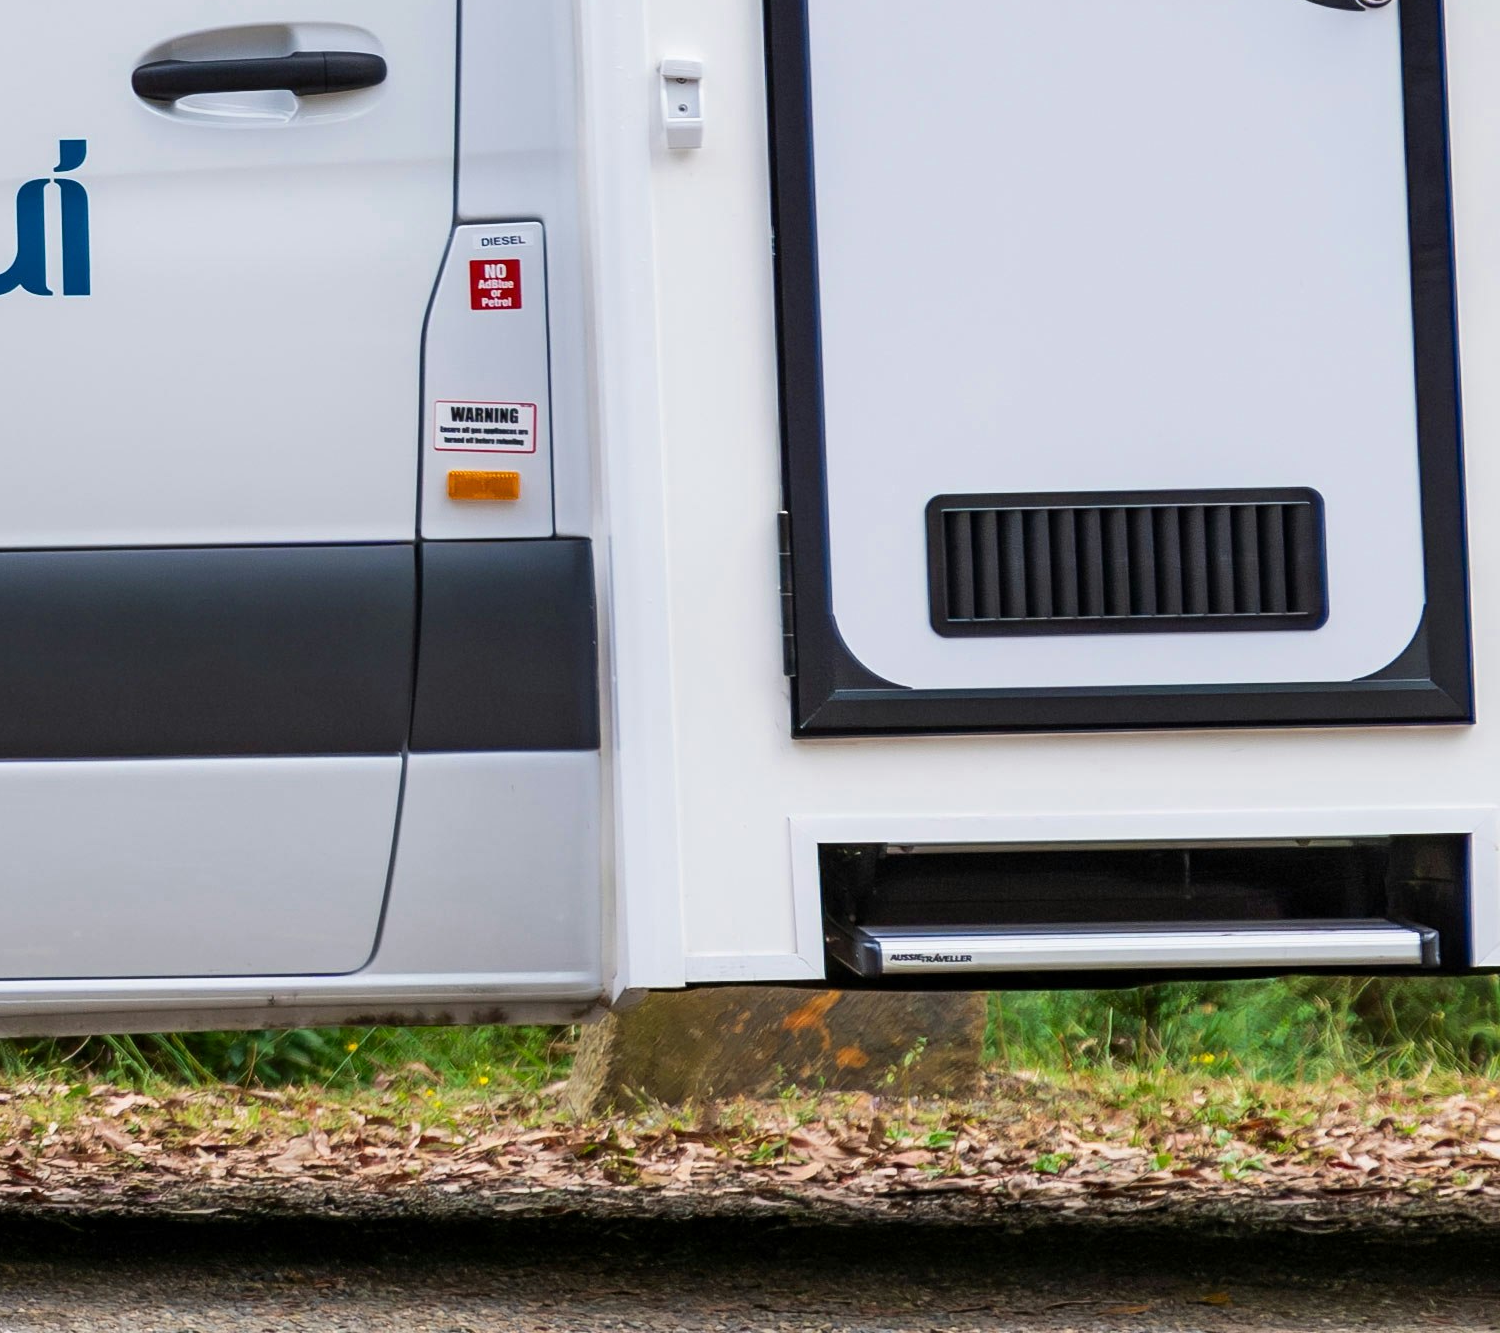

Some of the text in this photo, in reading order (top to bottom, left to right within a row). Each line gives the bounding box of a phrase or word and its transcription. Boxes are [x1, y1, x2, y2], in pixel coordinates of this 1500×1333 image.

[481, 235, 526, 247] DIESEL
[484, 263, 507, 279] NO
[477, 279, 514, 289] AdBlue
[490, 289, 502, 298] or
[481, 297, 512, 308] Petrol
[450, 406, 519, 424] WARNING
